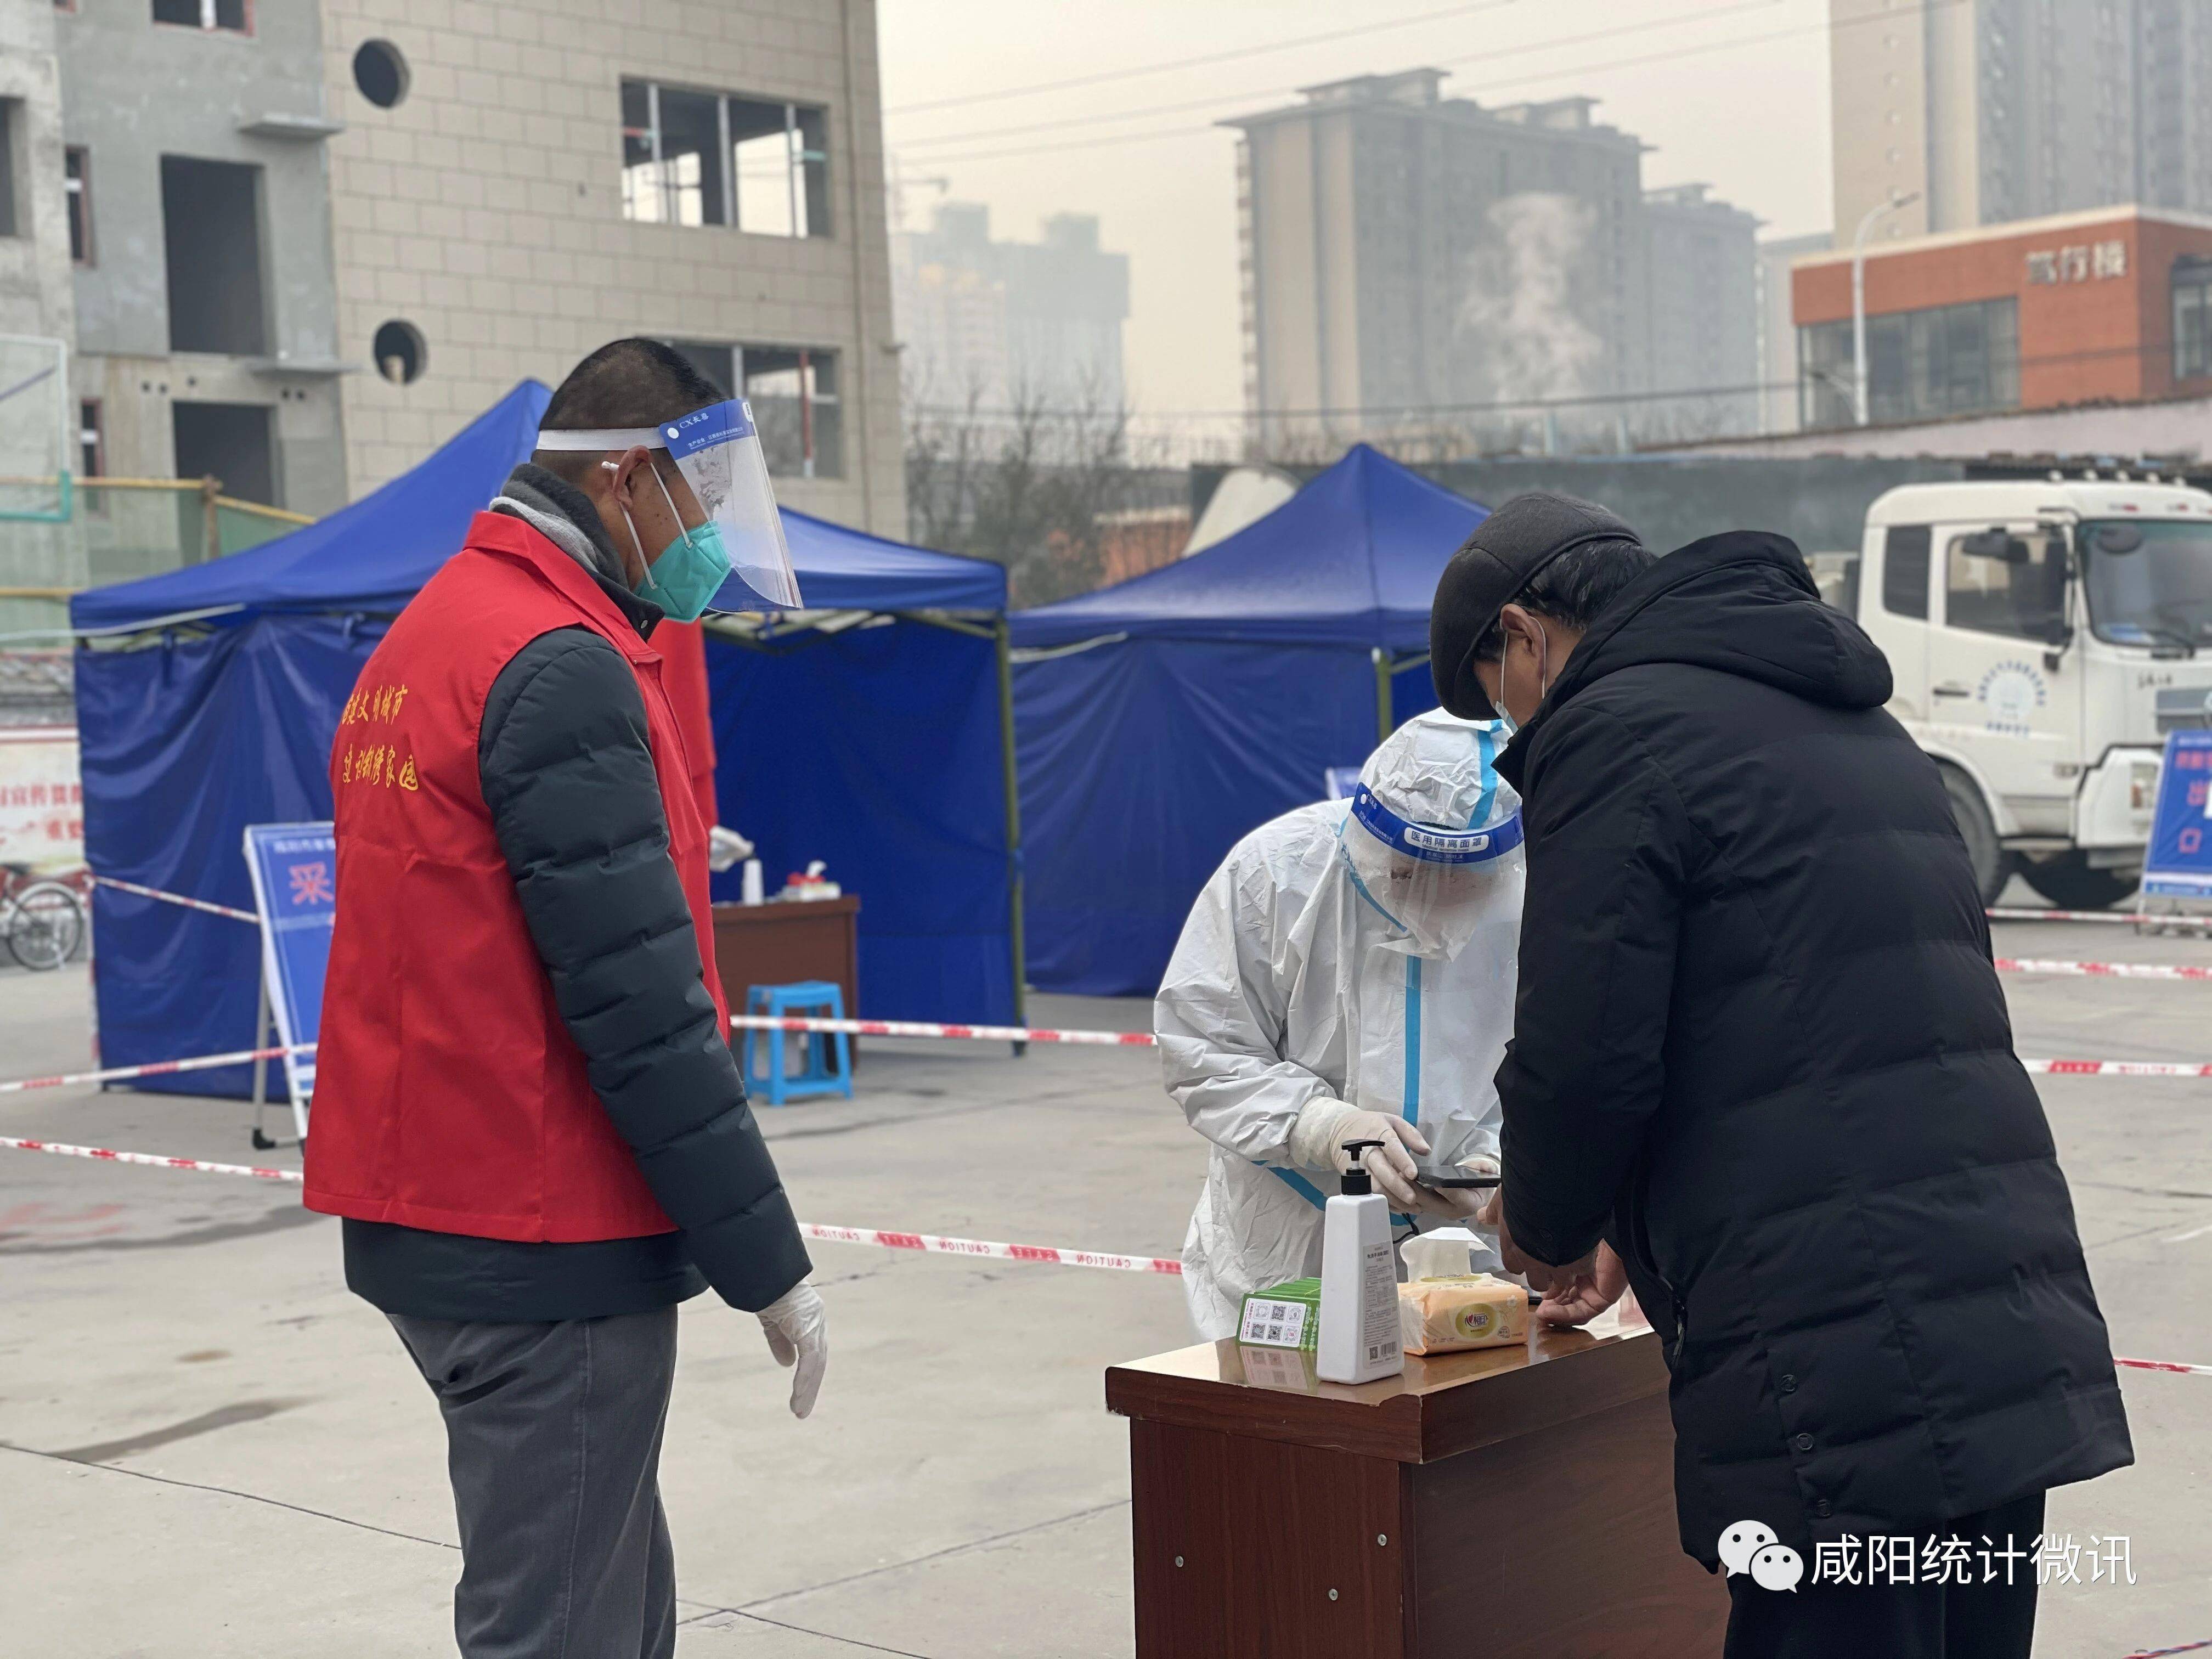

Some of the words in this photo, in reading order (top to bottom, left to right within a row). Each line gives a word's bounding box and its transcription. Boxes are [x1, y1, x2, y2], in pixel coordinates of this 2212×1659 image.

[1411, 830, 1482, 848] 医用隔离面罩
